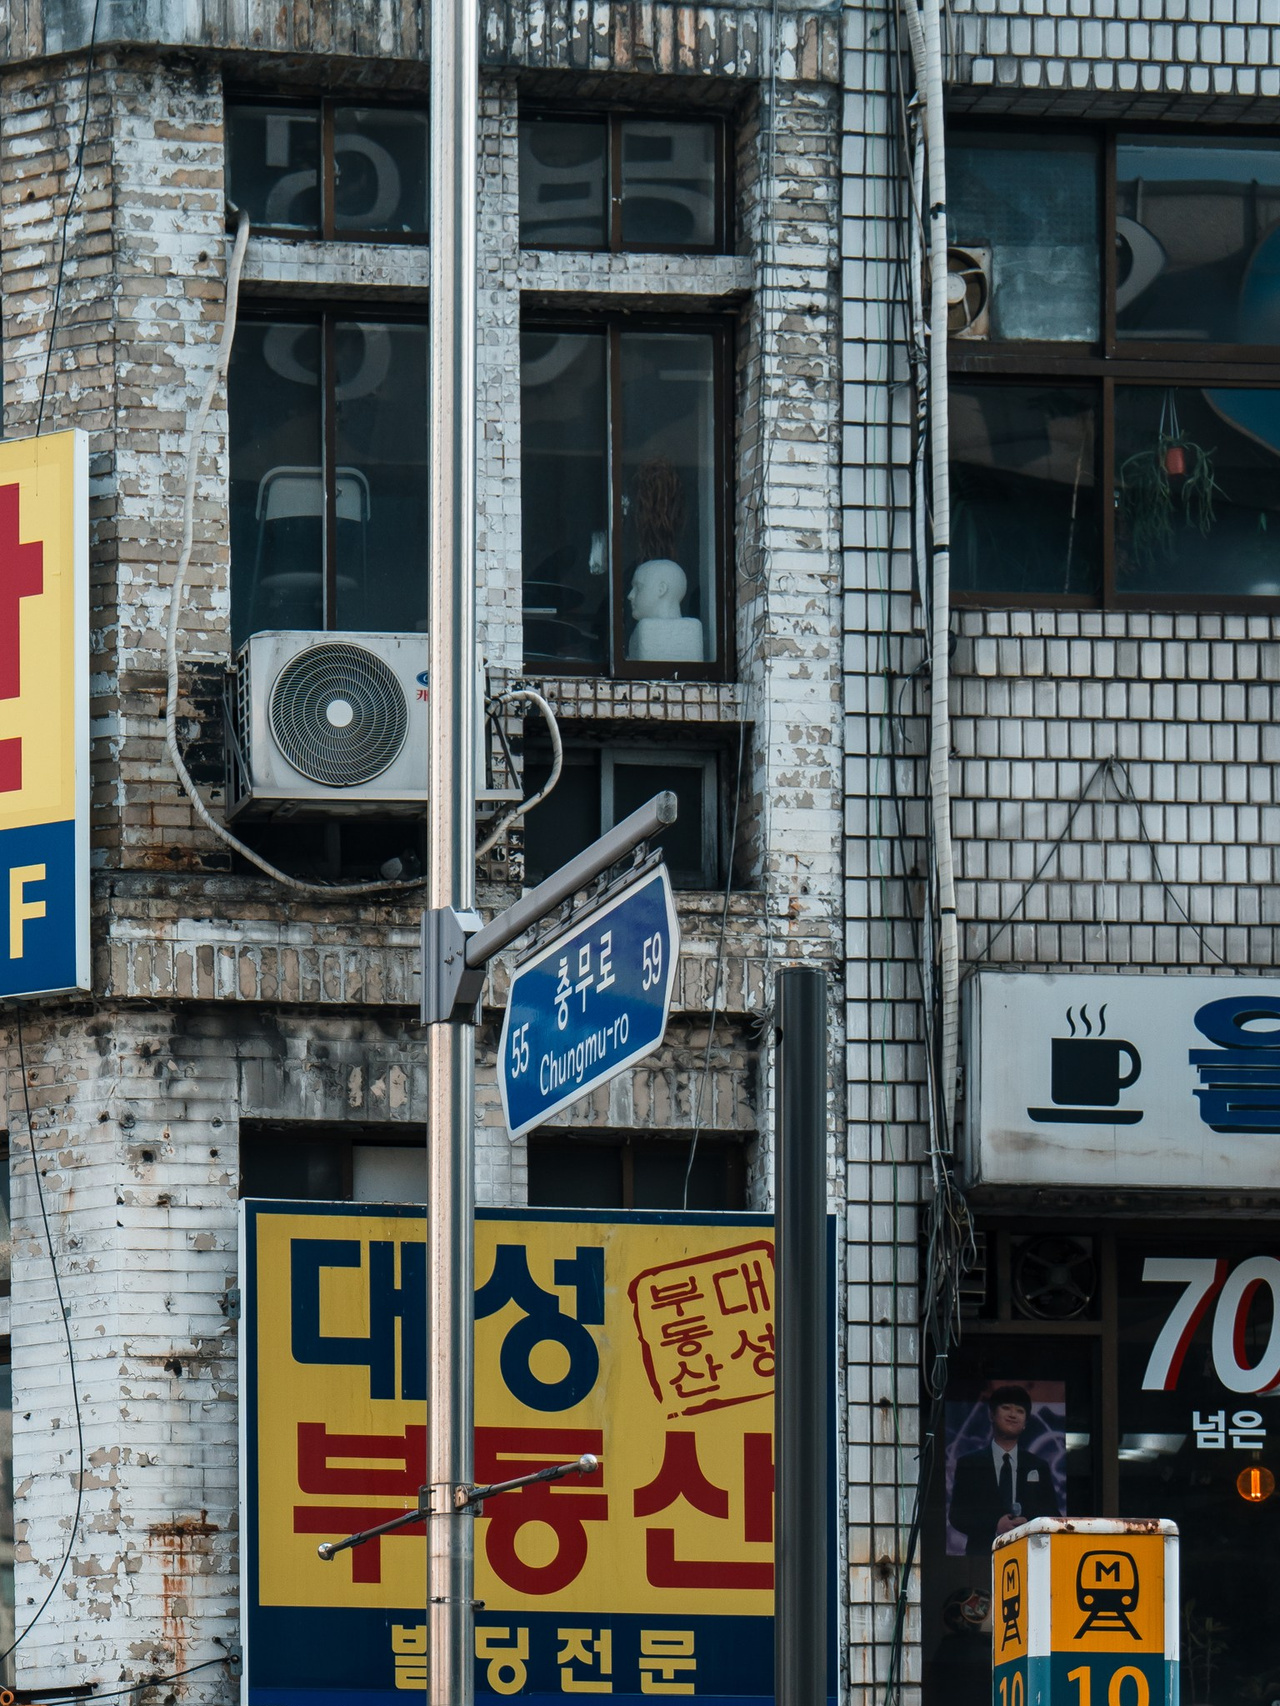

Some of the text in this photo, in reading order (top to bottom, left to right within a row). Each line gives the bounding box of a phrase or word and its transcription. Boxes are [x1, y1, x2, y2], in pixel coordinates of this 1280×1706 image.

[554, 929, 616, 1031] 충무로
[642, 932, 662, 991] 59
[511, 1022, 529, 1079] 55
[539, 1013, 629, 1096] Chungmu-ro
[290, 1238, 606, 1413] 대성
[1141, 1255, 1280, 1394] 70
[1192, 1410, 1267, 1449] 넘은
[293, 1422, 776, 1595] 부동산
[390, 1624, 697, 1696] 빌딩전문
